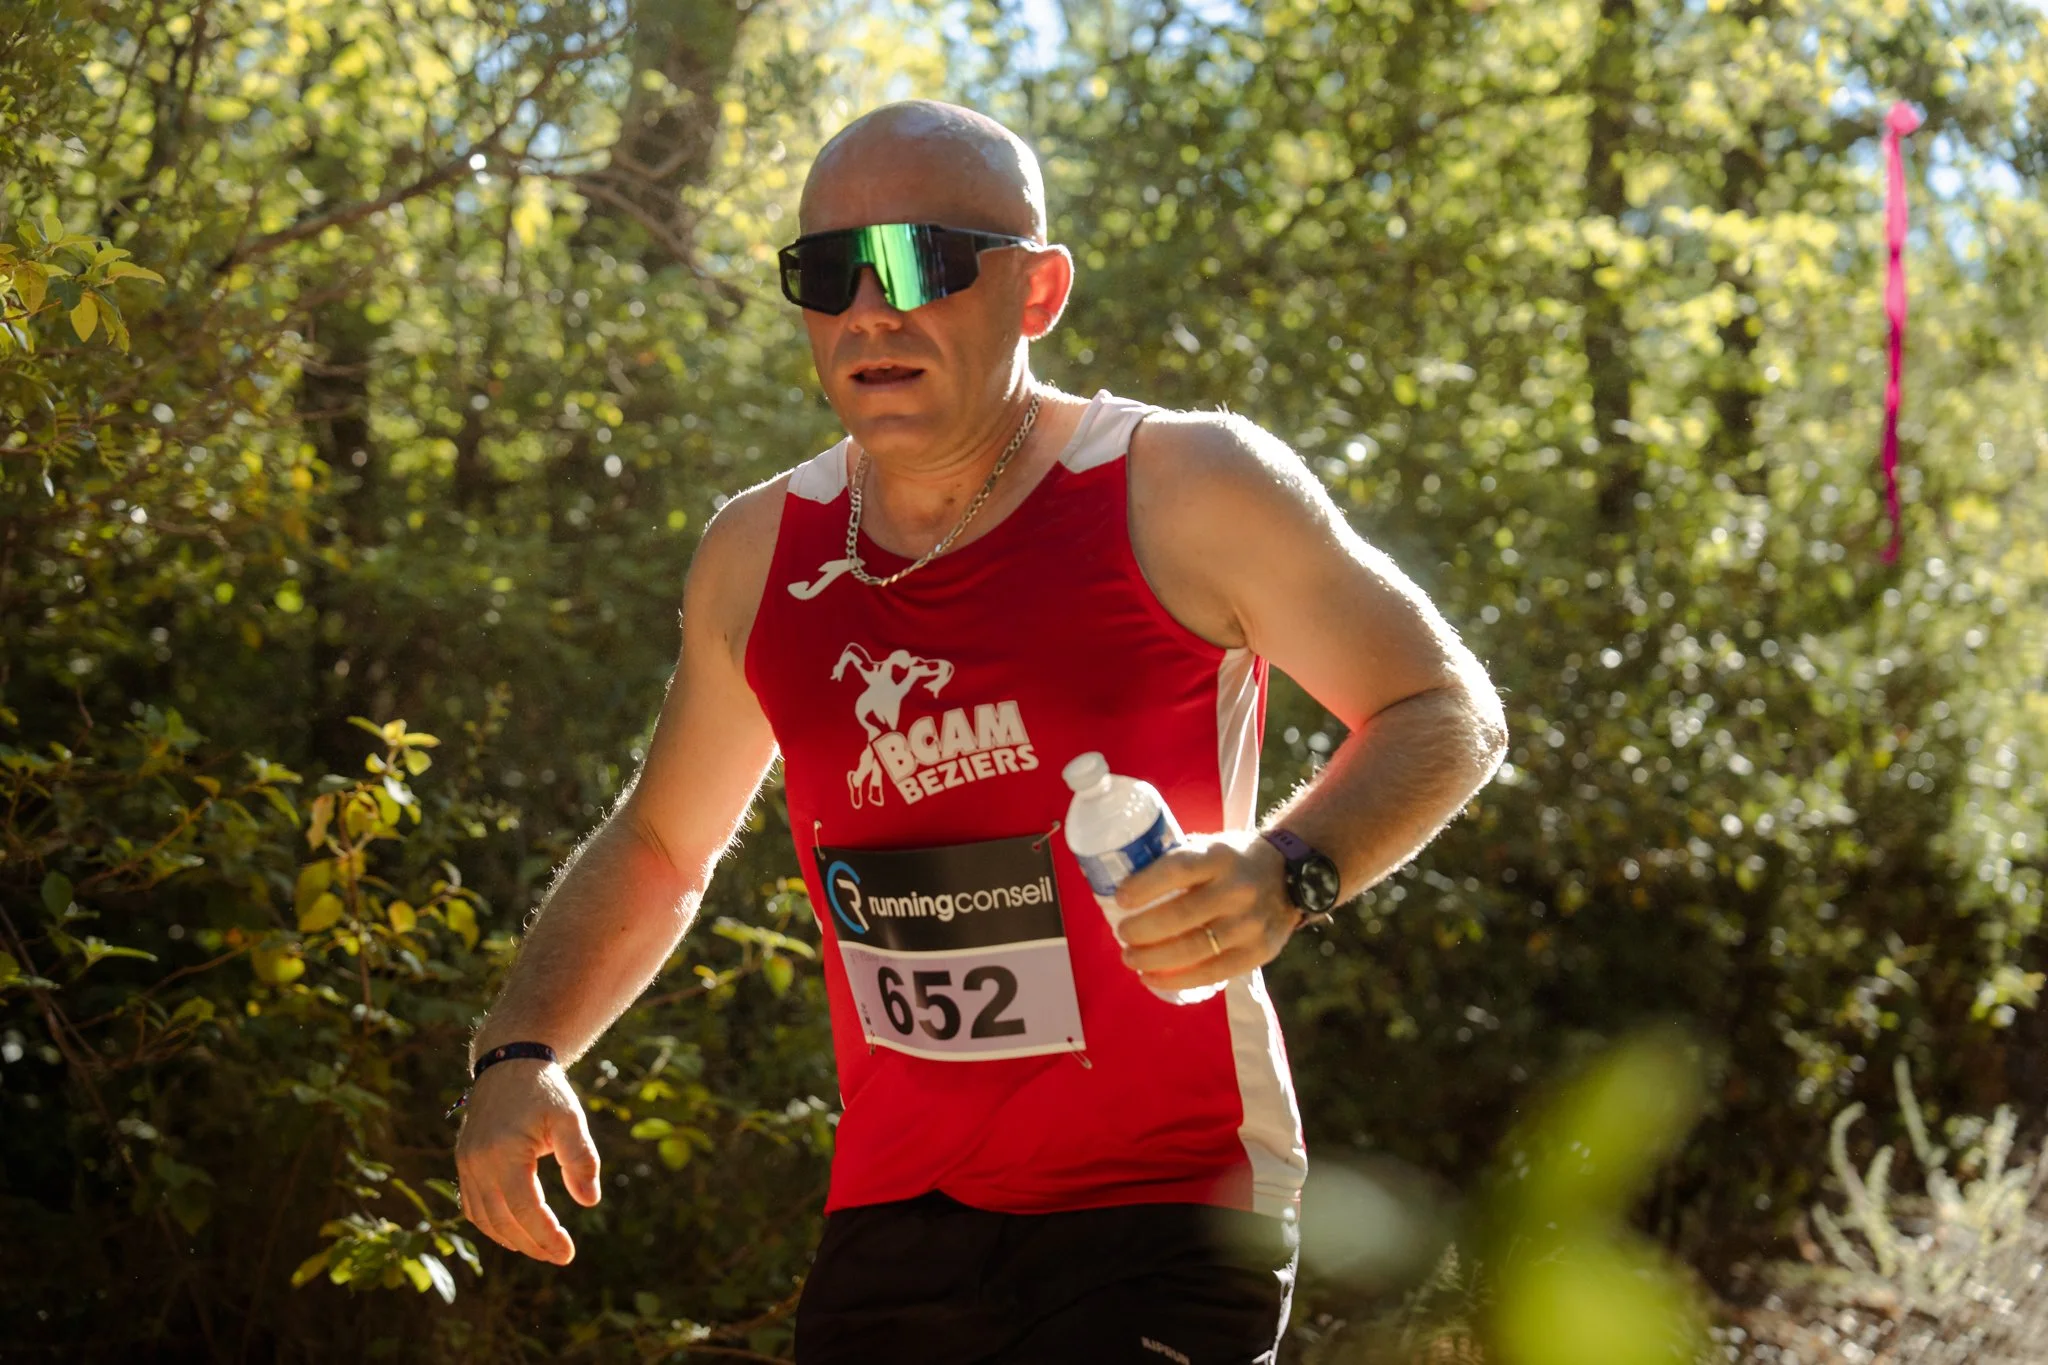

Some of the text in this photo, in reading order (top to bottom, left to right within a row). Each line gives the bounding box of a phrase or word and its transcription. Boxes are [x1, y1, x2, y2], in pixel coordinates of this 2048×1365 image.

[872, 700, 1030, 785] BCAM
[896, 744, 1039, 805] BEZIERS
[868, 876, 1053, 922] runningconseil
[877, 965, 1026, 1041] 652
